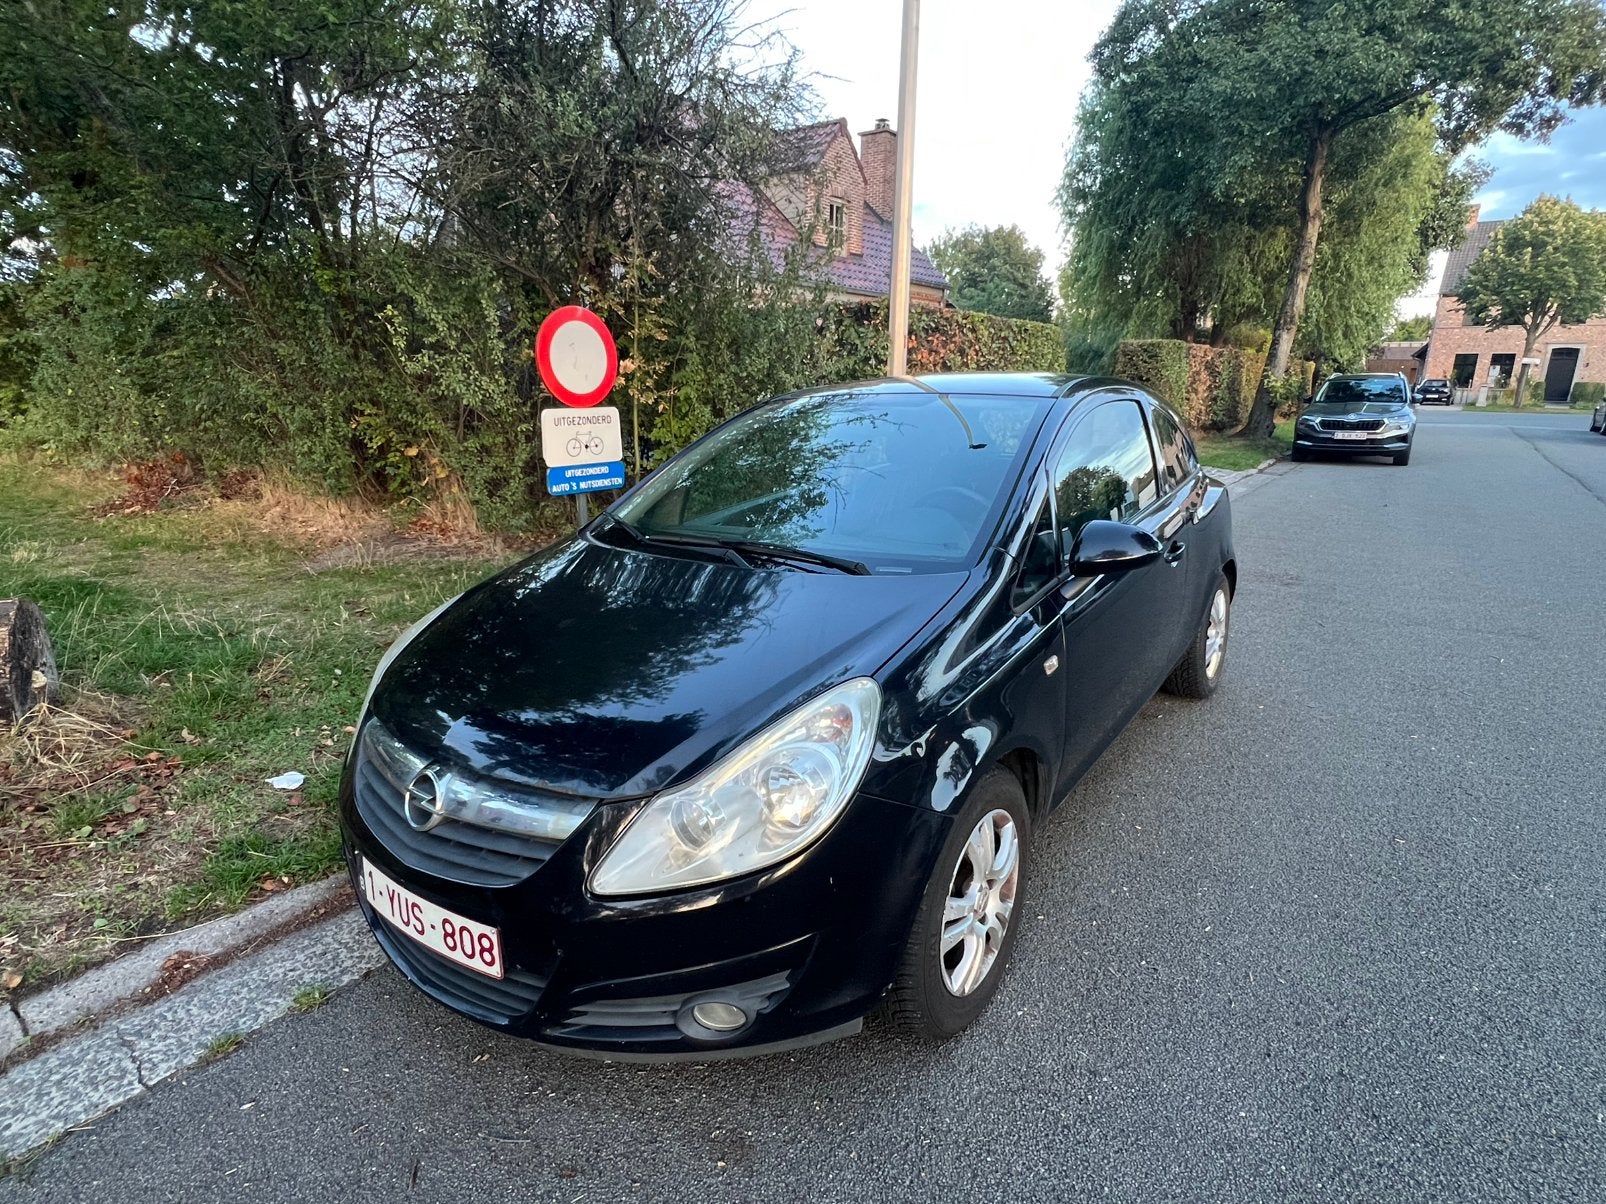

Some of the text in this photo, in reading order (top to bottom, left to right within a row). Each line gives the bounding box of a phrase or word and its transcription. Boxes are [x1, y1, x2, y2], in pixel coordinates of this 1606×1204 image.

[554, 415, 612, 426] UITGEZONDERD
[565, 466, 609, 478] UITGEZONDERD
[552, 483, 570, 493] AUTO
[579, 478, 623, 490] NUTSDIENSTEN
[368, 870, 496, 967] 1-YUS-808
